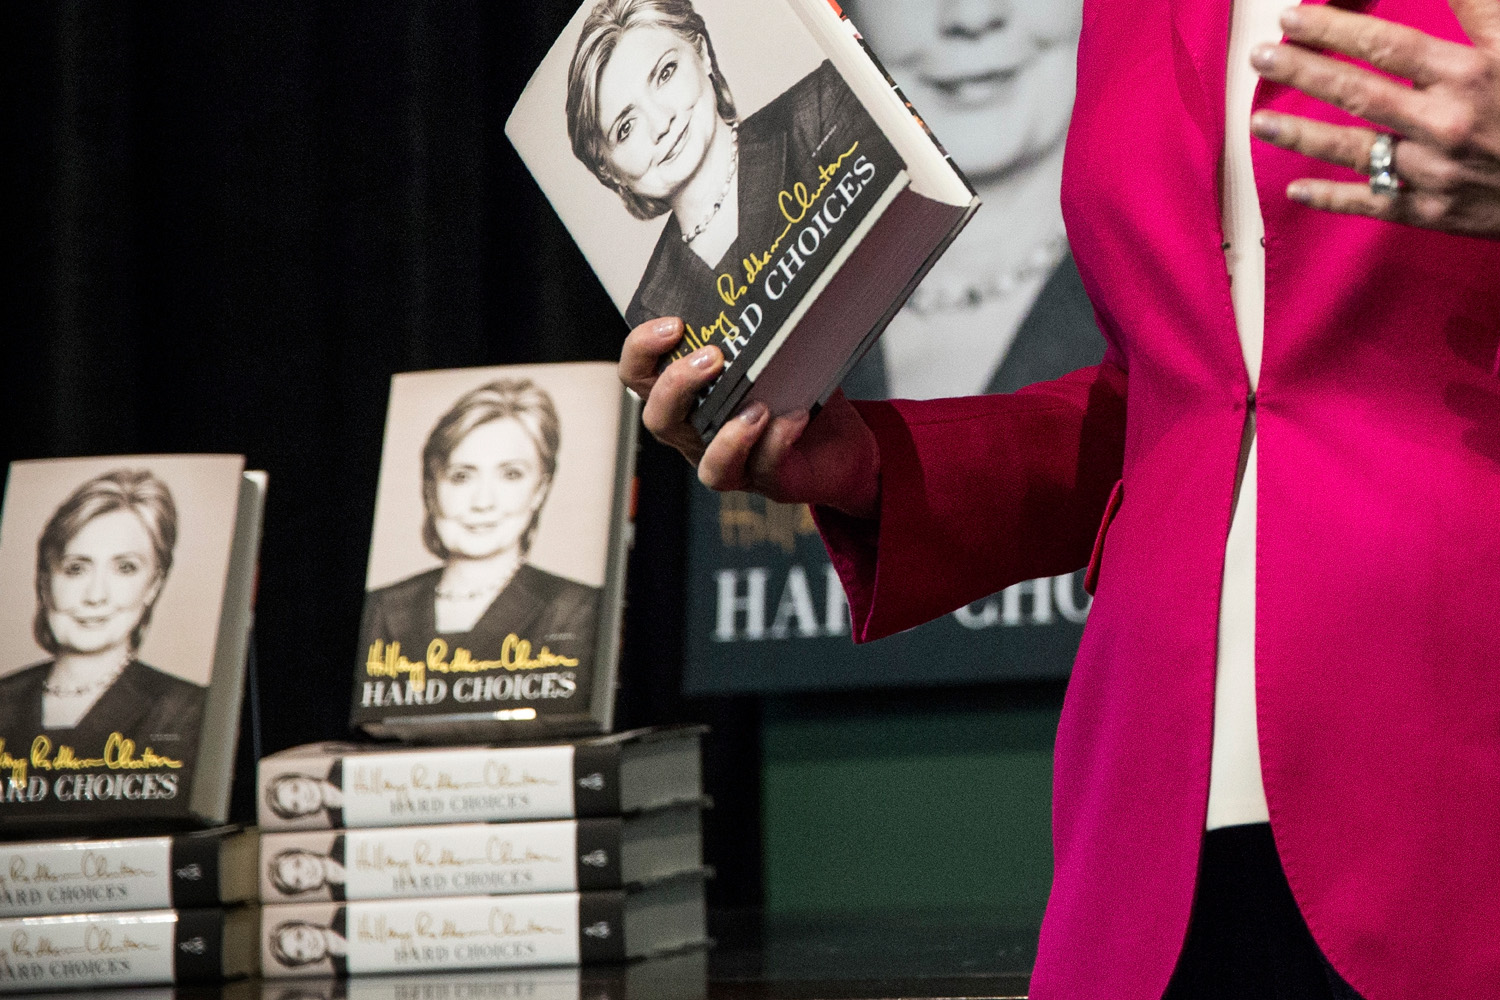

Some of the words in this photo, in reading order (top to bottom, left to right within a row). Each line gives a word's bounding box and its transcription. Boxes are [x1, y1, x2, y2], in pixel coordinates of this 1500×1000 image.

[778, 140, 859, 224] Clinton
[764, 155, 876, 301] CHOICES
[360, 678, 448, 708] HARD
[453, 671, 577, 703] CHOICES
[53, 772, 180, 801] CHOICES
